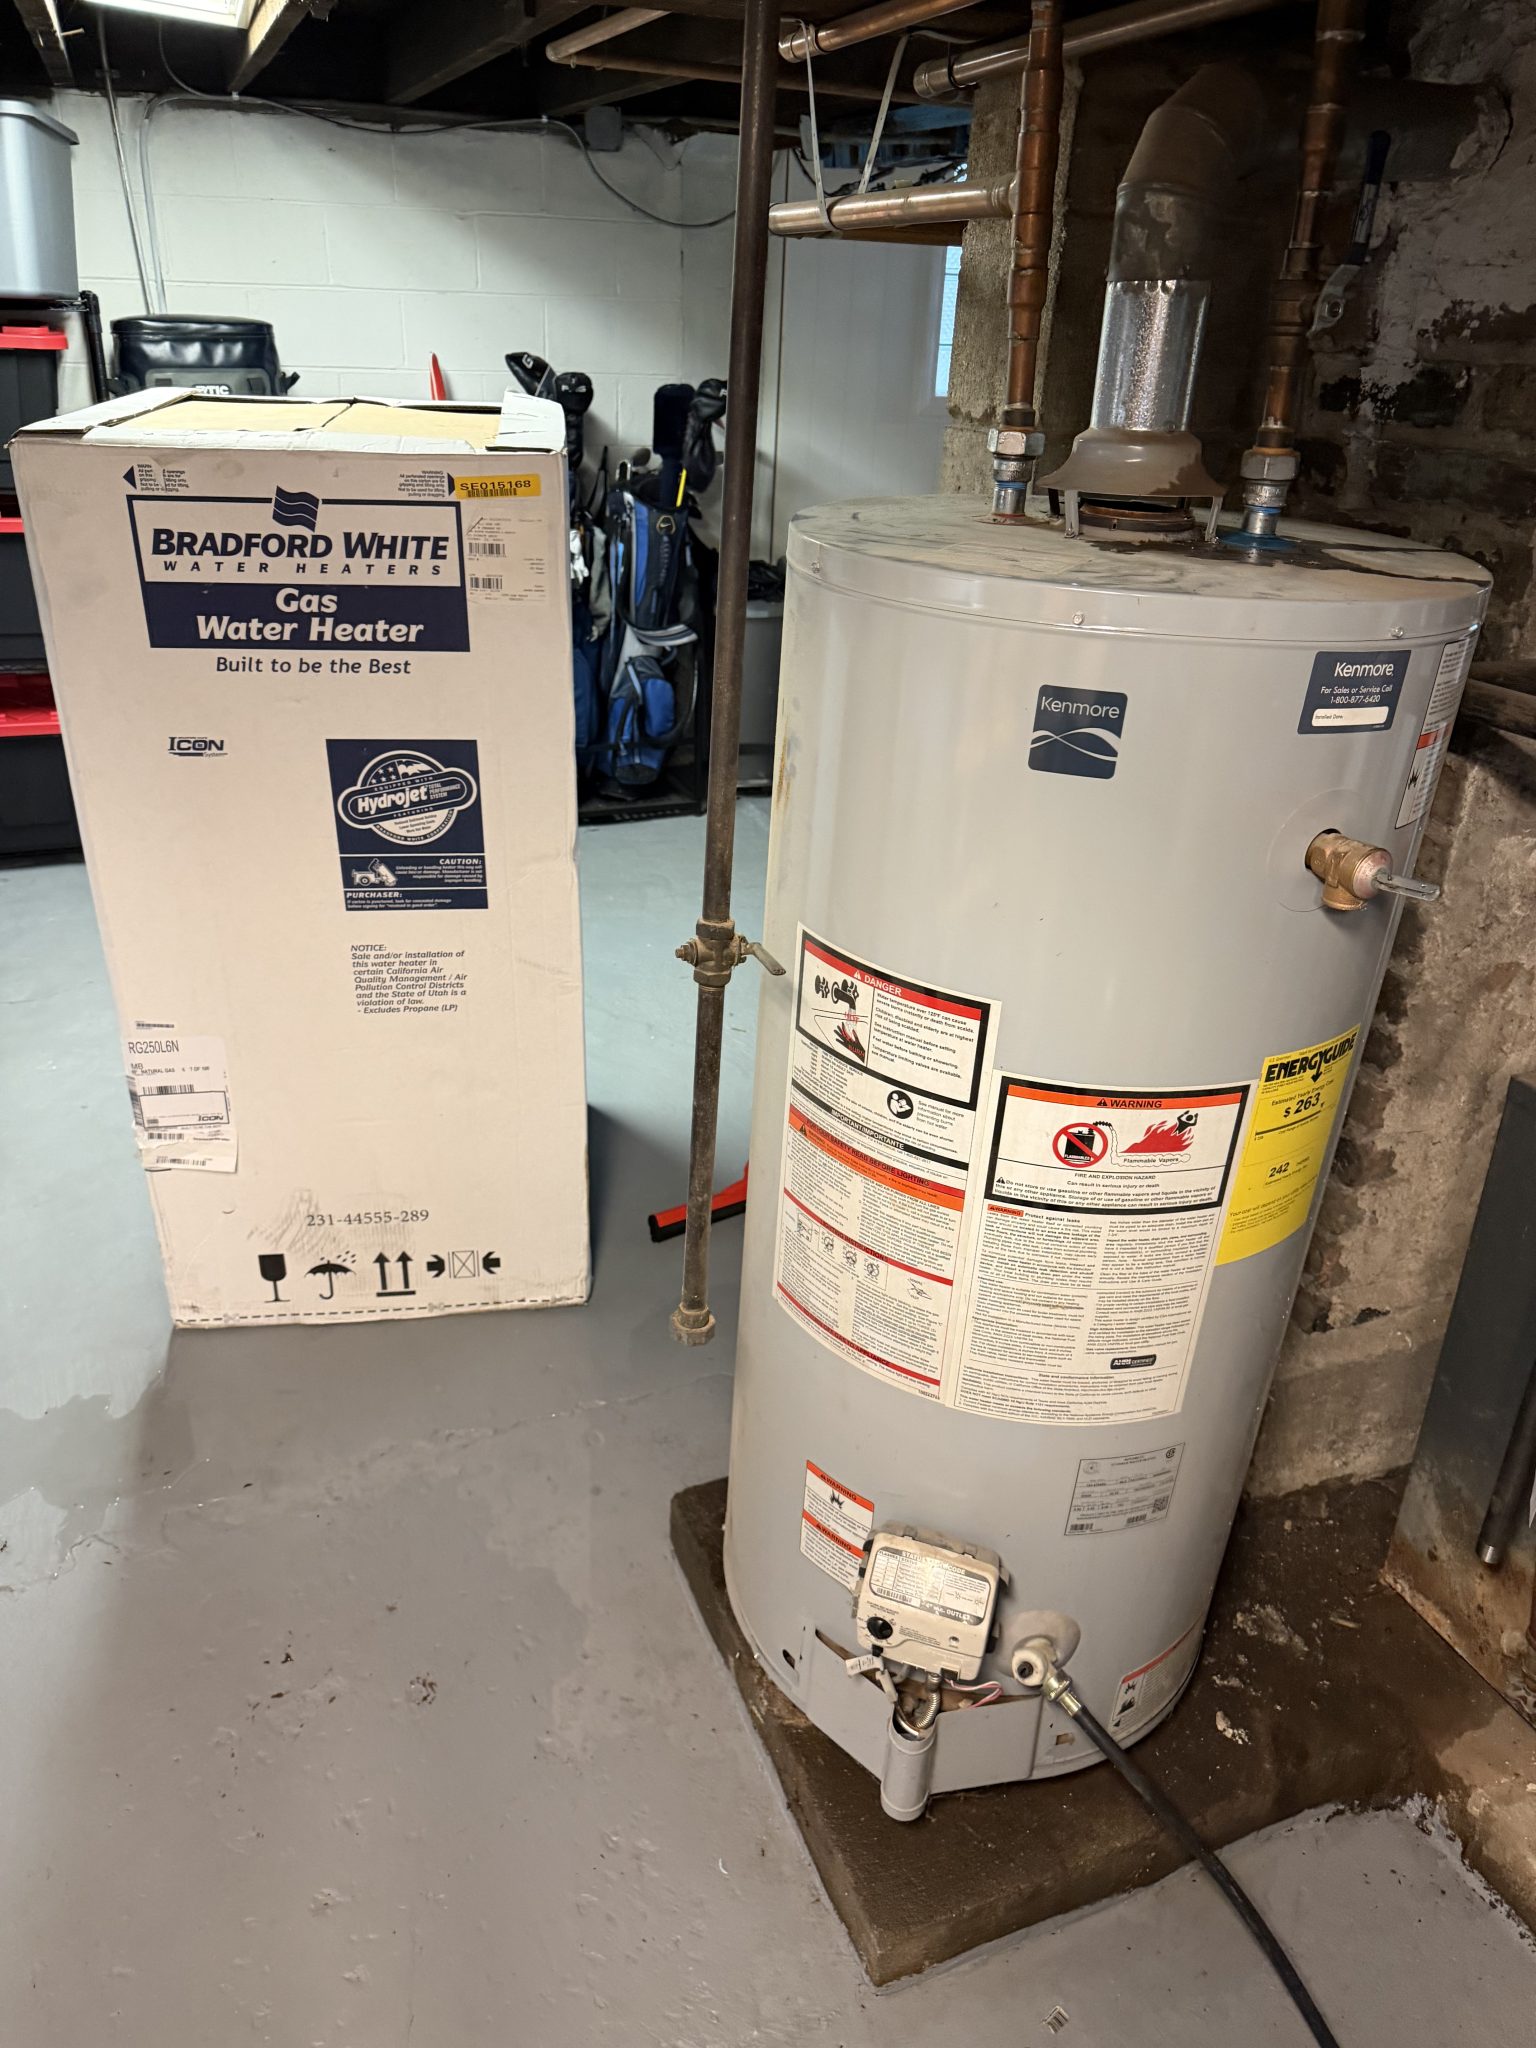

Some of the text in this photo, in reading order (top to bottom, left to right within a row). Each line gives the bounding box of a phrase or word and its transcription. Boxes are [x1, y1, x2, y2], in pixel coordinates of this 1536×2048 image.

[460, 480, 531, 491] SE015168
[151, 528, 449, 560] BRADFORD WHITE
[163, 560, 441, 576] WATER HEATERS
[275, 587, 338, 613] Gas
[196, 615, 424, 642] Water Heater
[216, 656, 412, 675] Built to be the Best
[1334, 662, 1394, 677] Kenmore
[1321, 686, 1332, 694] For
[1333, 686, 1350, 694] Sales
[1359, 685, 1380, 693] Service
[1381, 684, 1393, 693] Call
[1330, 695, 1381, 704] 1-800-877-6420
[1040, 696, 1120, 719] Kenmore
[374, 780, 411, 791] EQUIPPED
[357, 785, 428, 815] Hydrojet
[430, 792, 448, 800] SYSTEM
[393, 807, 434, 818] FEATURING
[346, 891, 402, 899] PURCHASER:
[350, 944, 387, 952] NOTICE:
[386, 967, 428, 975] California
[354, 976, 387, 984] Quality
[389, 974, 446, 983] Management
[864, 975, 902, 996] DANGER
[355, 983, 393, 991] Pollution
[395, 982, 427, 990] Control
[391, 990, 415, 998] State
[428, 989, 449, 997] Utah
[364, 1006, 401, 1014] Excludes
[403, 1005, 439, 1013] Propane
[441, 1004, 458, 1012] (LP)
[128, 1040, 180, 1054] RG250L6N
[1264, 1032, 1358, 1083] ENERGYGUIDE
[1110, 1100, 1162, 1109] WARNING
[1294, 1092, 1321, 1115] 263
[831, 1133, 852, 1153] SAFETY
[852, 1147, 869, 1162] READ
[870, 1156, 895, 1174] BEFORE
[897, 1168, 930, 1186] LIGHTING
[1269, 1162, 1290, 1178] 242
[1058, 1188, 1081, 1196] gasoline
[307, 1209, 429, 1227] 231-44555-289
[825, 1476, 857, 1501] WARNING
[820, 1526, 852, 1551] WARNING
